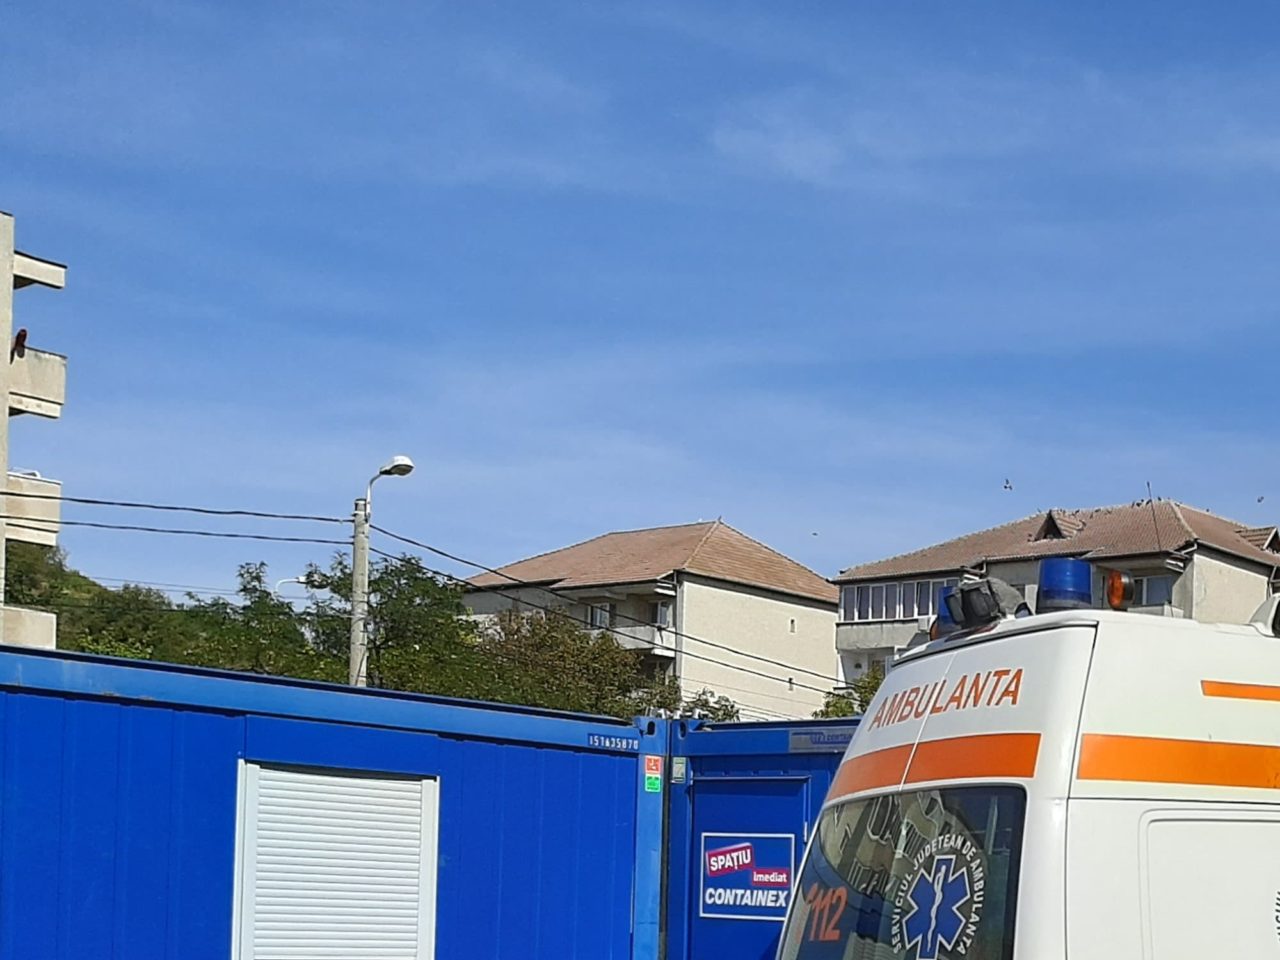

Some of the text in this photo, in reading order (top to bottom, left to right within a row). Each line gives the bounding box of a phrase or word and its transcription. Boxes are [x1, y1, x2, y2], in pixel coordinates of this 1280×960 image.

[867, 668, 1023, 732] AMBULANTA
[705, 887, 789, 907] CONTAINEX
[809, 886, 848, 941] 112
[891, 834, 985, 955] SERVICIUL JUDETEAN DE AMBULANTA
